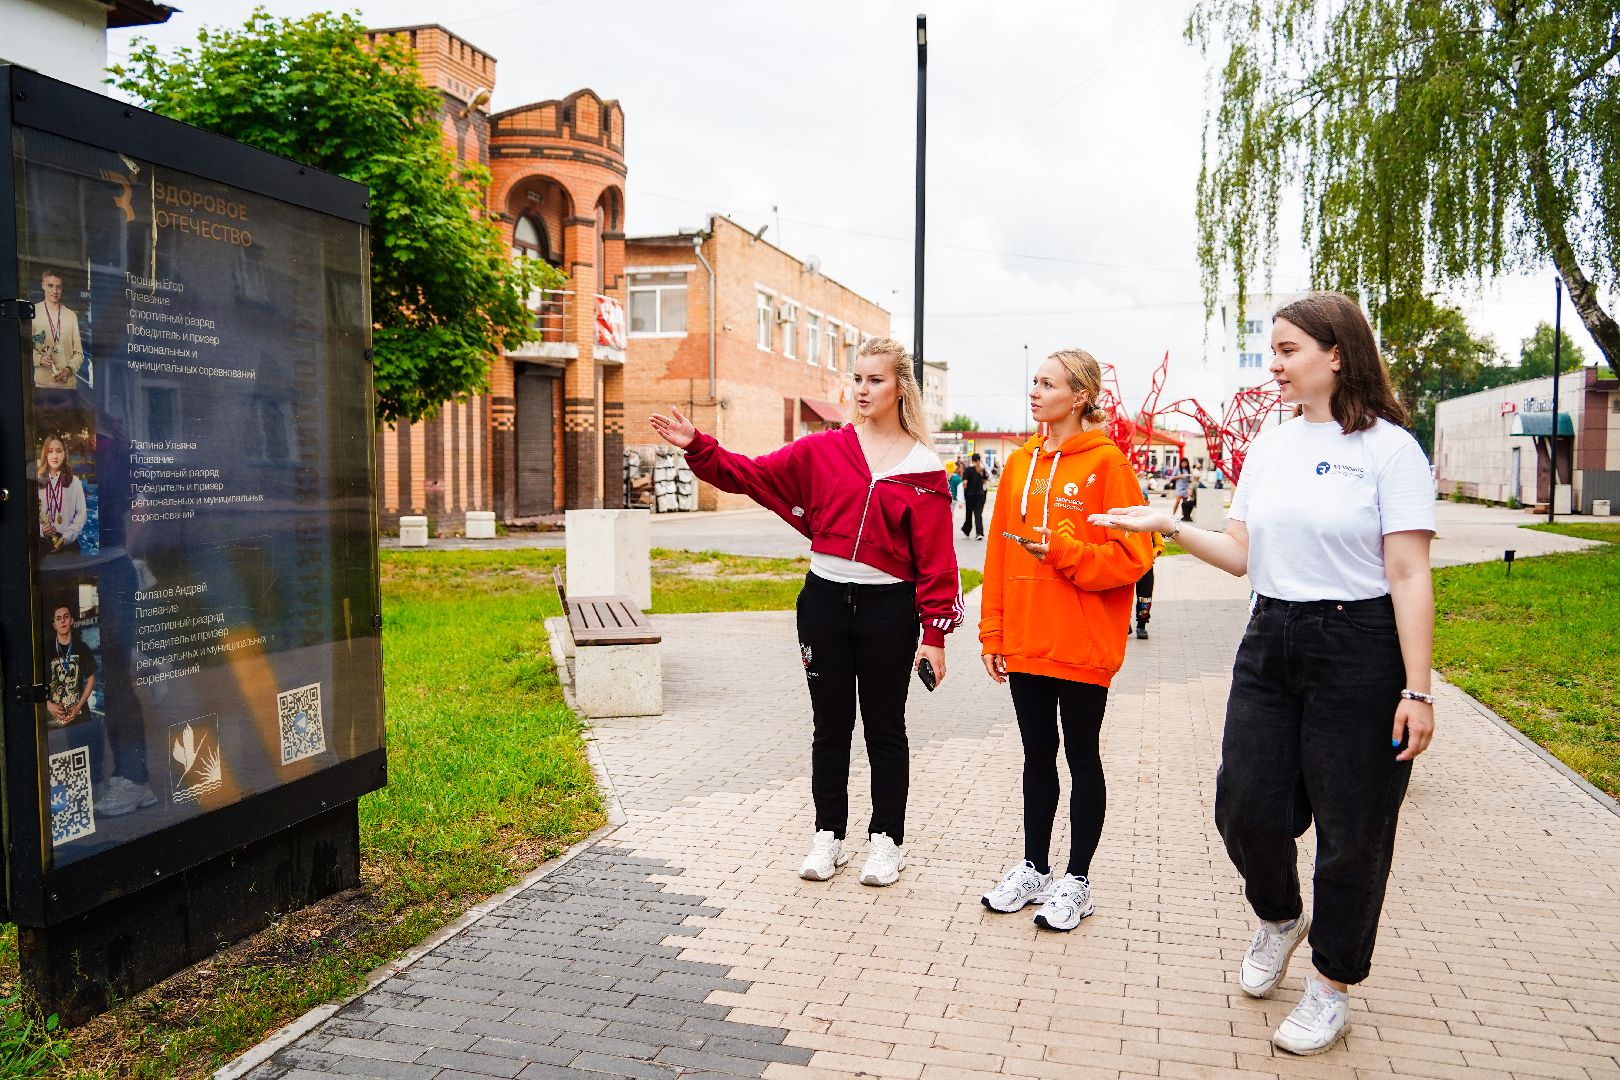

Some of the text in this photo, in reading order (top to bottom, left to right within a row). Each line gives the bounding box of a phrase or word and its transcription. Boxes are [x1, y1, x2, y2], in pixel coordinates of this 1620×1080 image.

[155, 182, 248, 221] ЗДОРОВОЕ
[156, 210, 252, 247] ОТЕЧЕСТВО
[125, 271, 184, 292] Трошн Егор
[125, 289, 170, 306] Плавание
[129, 308, 215, 329] спортивный разряд
[126, 323, 220, 346] Победитель и призер
[127, 342, 198, 358] региональных и
[127, 360, 256, 379] муниципальных соревнований
[165, 440, 197, 450] Ульяна
[130, 454, 175, 464] Плавание
[134, 468, 187, 480] спортивный
[189, 469, 220, 480] разряд
[131, 483, 185, 494] Победитель
[193, 482, 224, 493] призер
[131, 497, 195, 510] региональных
[203, 494, 264, 506] муниципальных
[131, 510, 195, 523] соревнований
[175, 582, 208, 597] Андрей
[135, 604, 179, 619] Плавание
[138, 616, 191, 635] спортивный
[192, 612, 225, 627] разряд
[136, 638, 189, 653] Победитель
[197, 628, 229, 642] призер
[136, 649, 199, 671] региональных
[206, 635, 267, 656] муниципальных
[136, 663, 200, 686] соревнований
